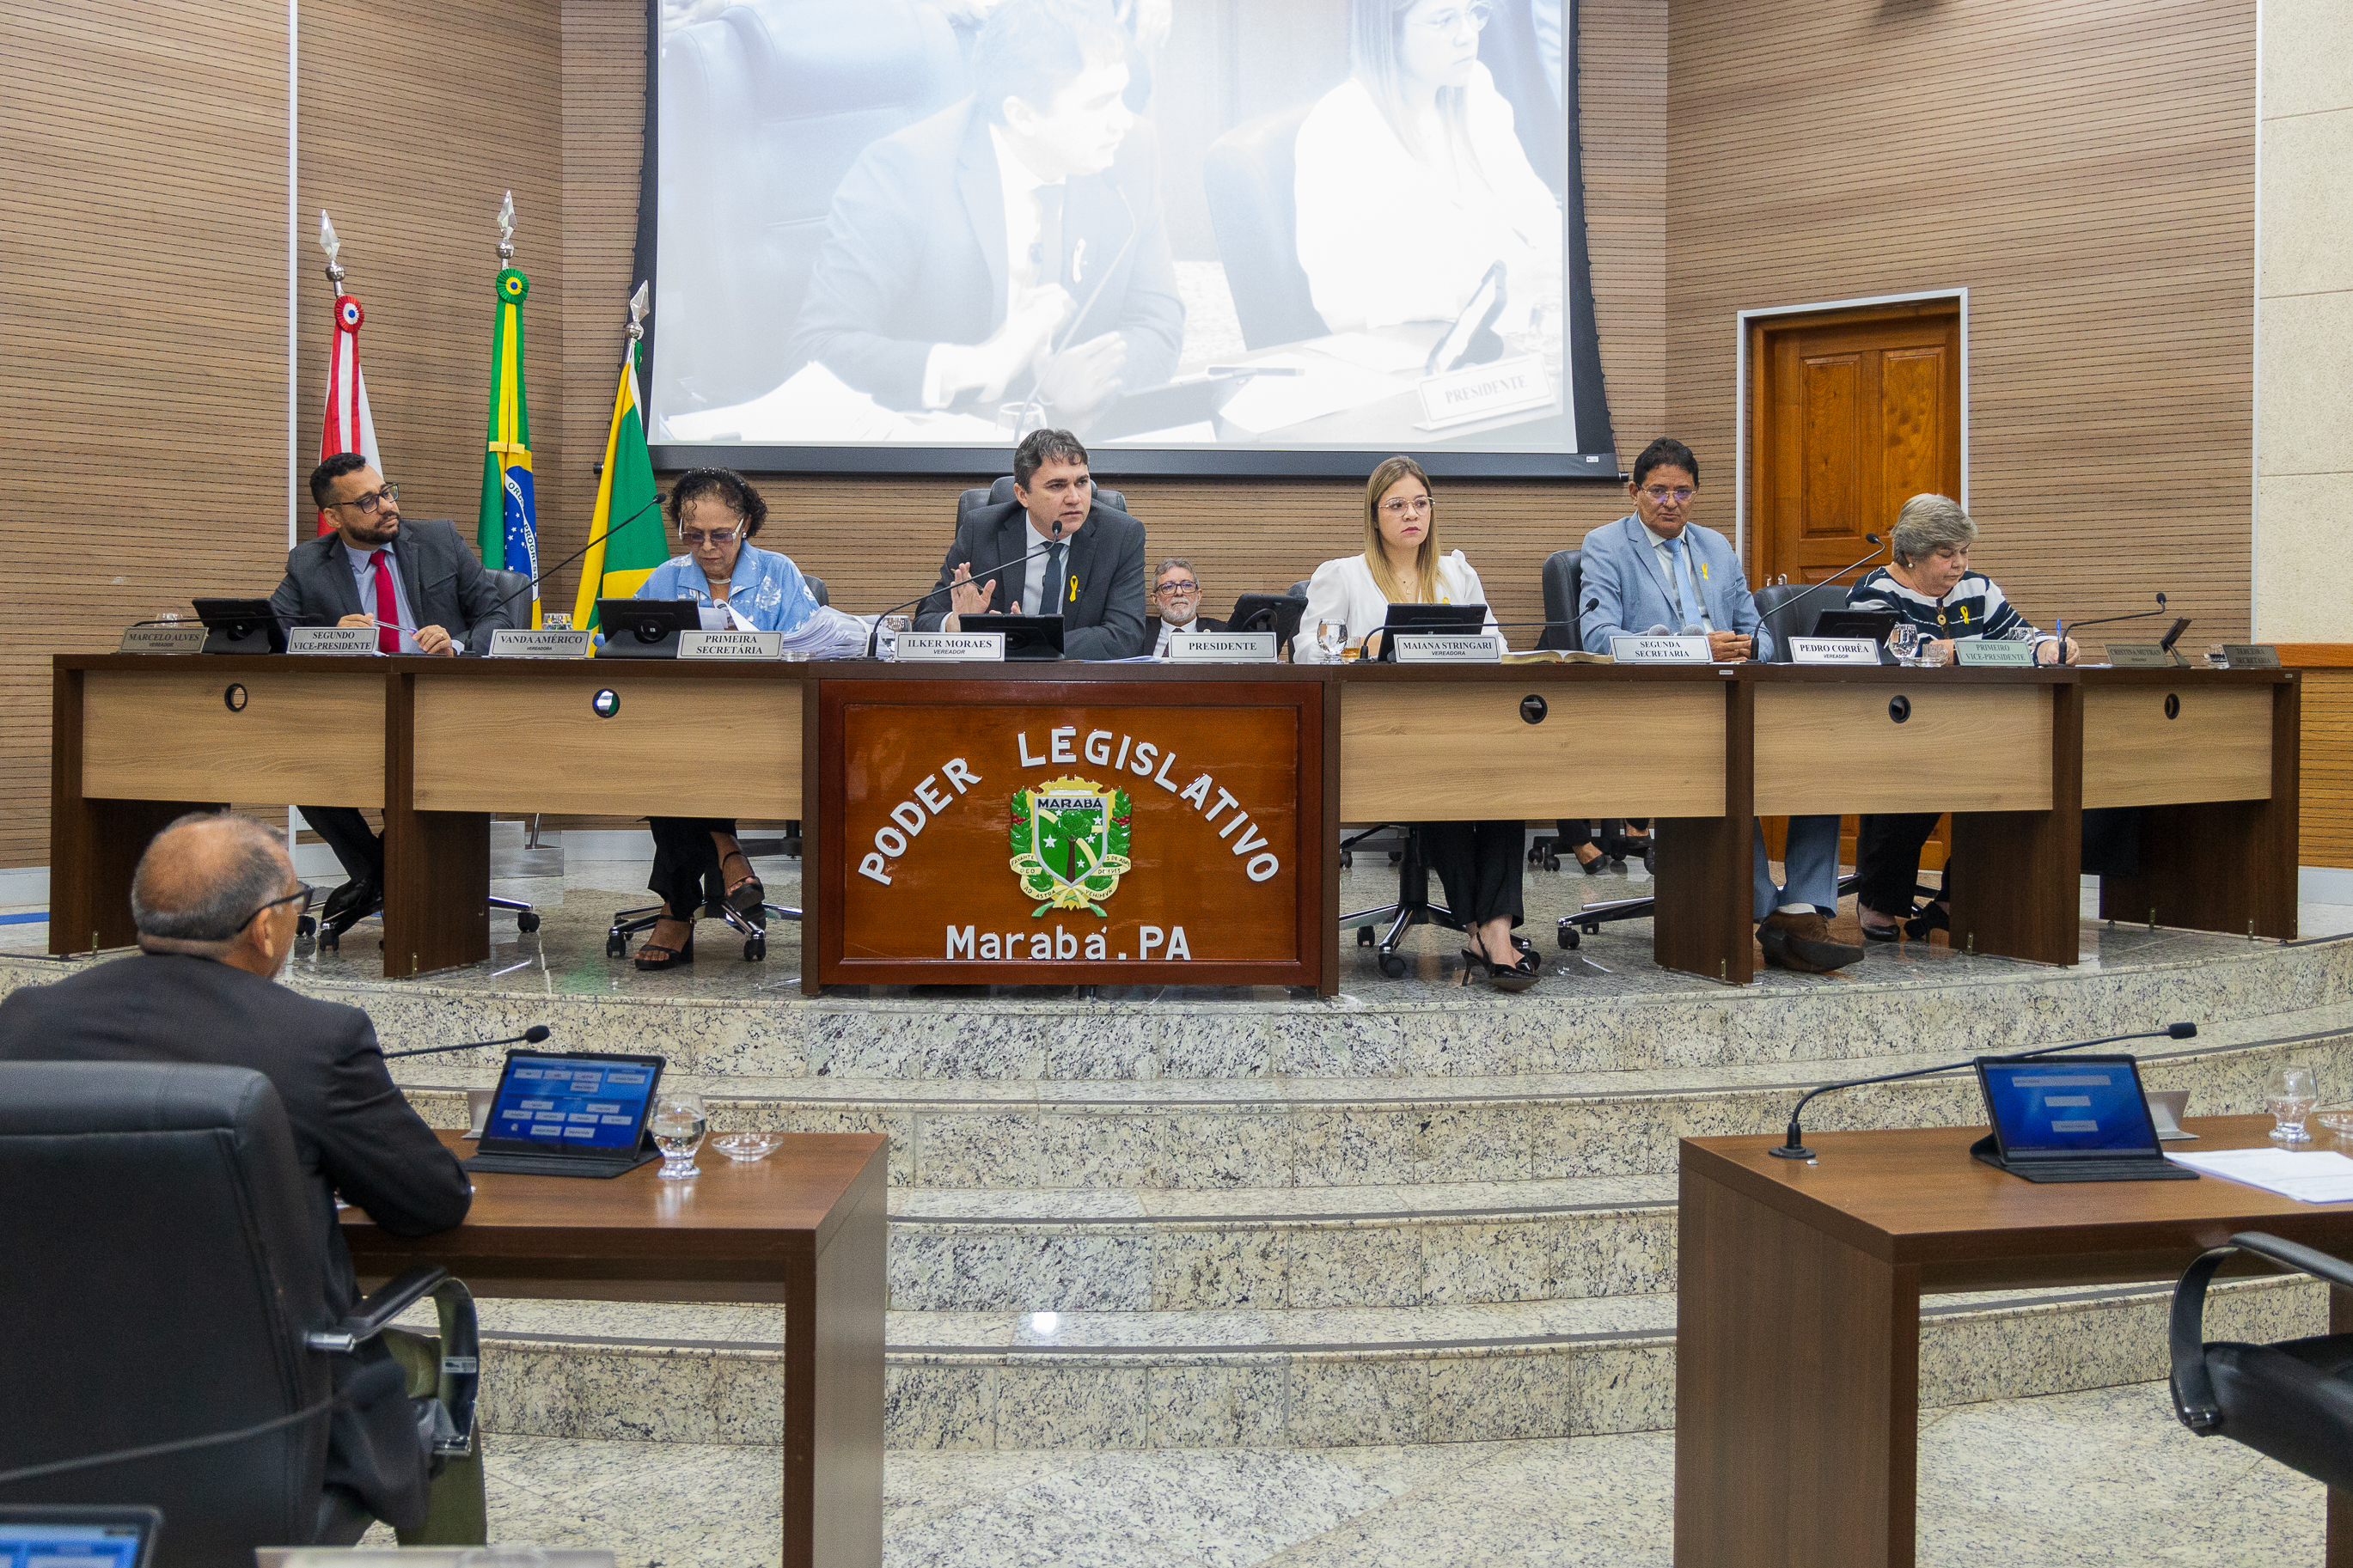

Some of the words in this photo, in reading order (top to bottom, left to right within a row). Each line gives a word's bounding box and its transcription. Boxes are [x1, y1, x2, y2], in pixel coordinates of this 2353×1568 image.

[1445, 375, 1528, 404] PRESIDENTE
[312, 631, 355, 639] SEGUNDO
[535, 634, 583, 644] AMÉRICO
[908, 639, 943, 648] ILKER
[944, 639, 993, 648] MORAES
[1189, 642, 1257, 650] PRESIDENTE
[1831, 643, 1869, 653] CORRÊA
[696, 644, 763, 654] SECRETÁRIA
[1635, 649, 1690, 657] SECRETÁRIA
[858, 757, 982, 885] PODER
[1017, 727, 1279, 882] LEGISLATIVO
[1037, 797, 1103, 808] MARABÁ
